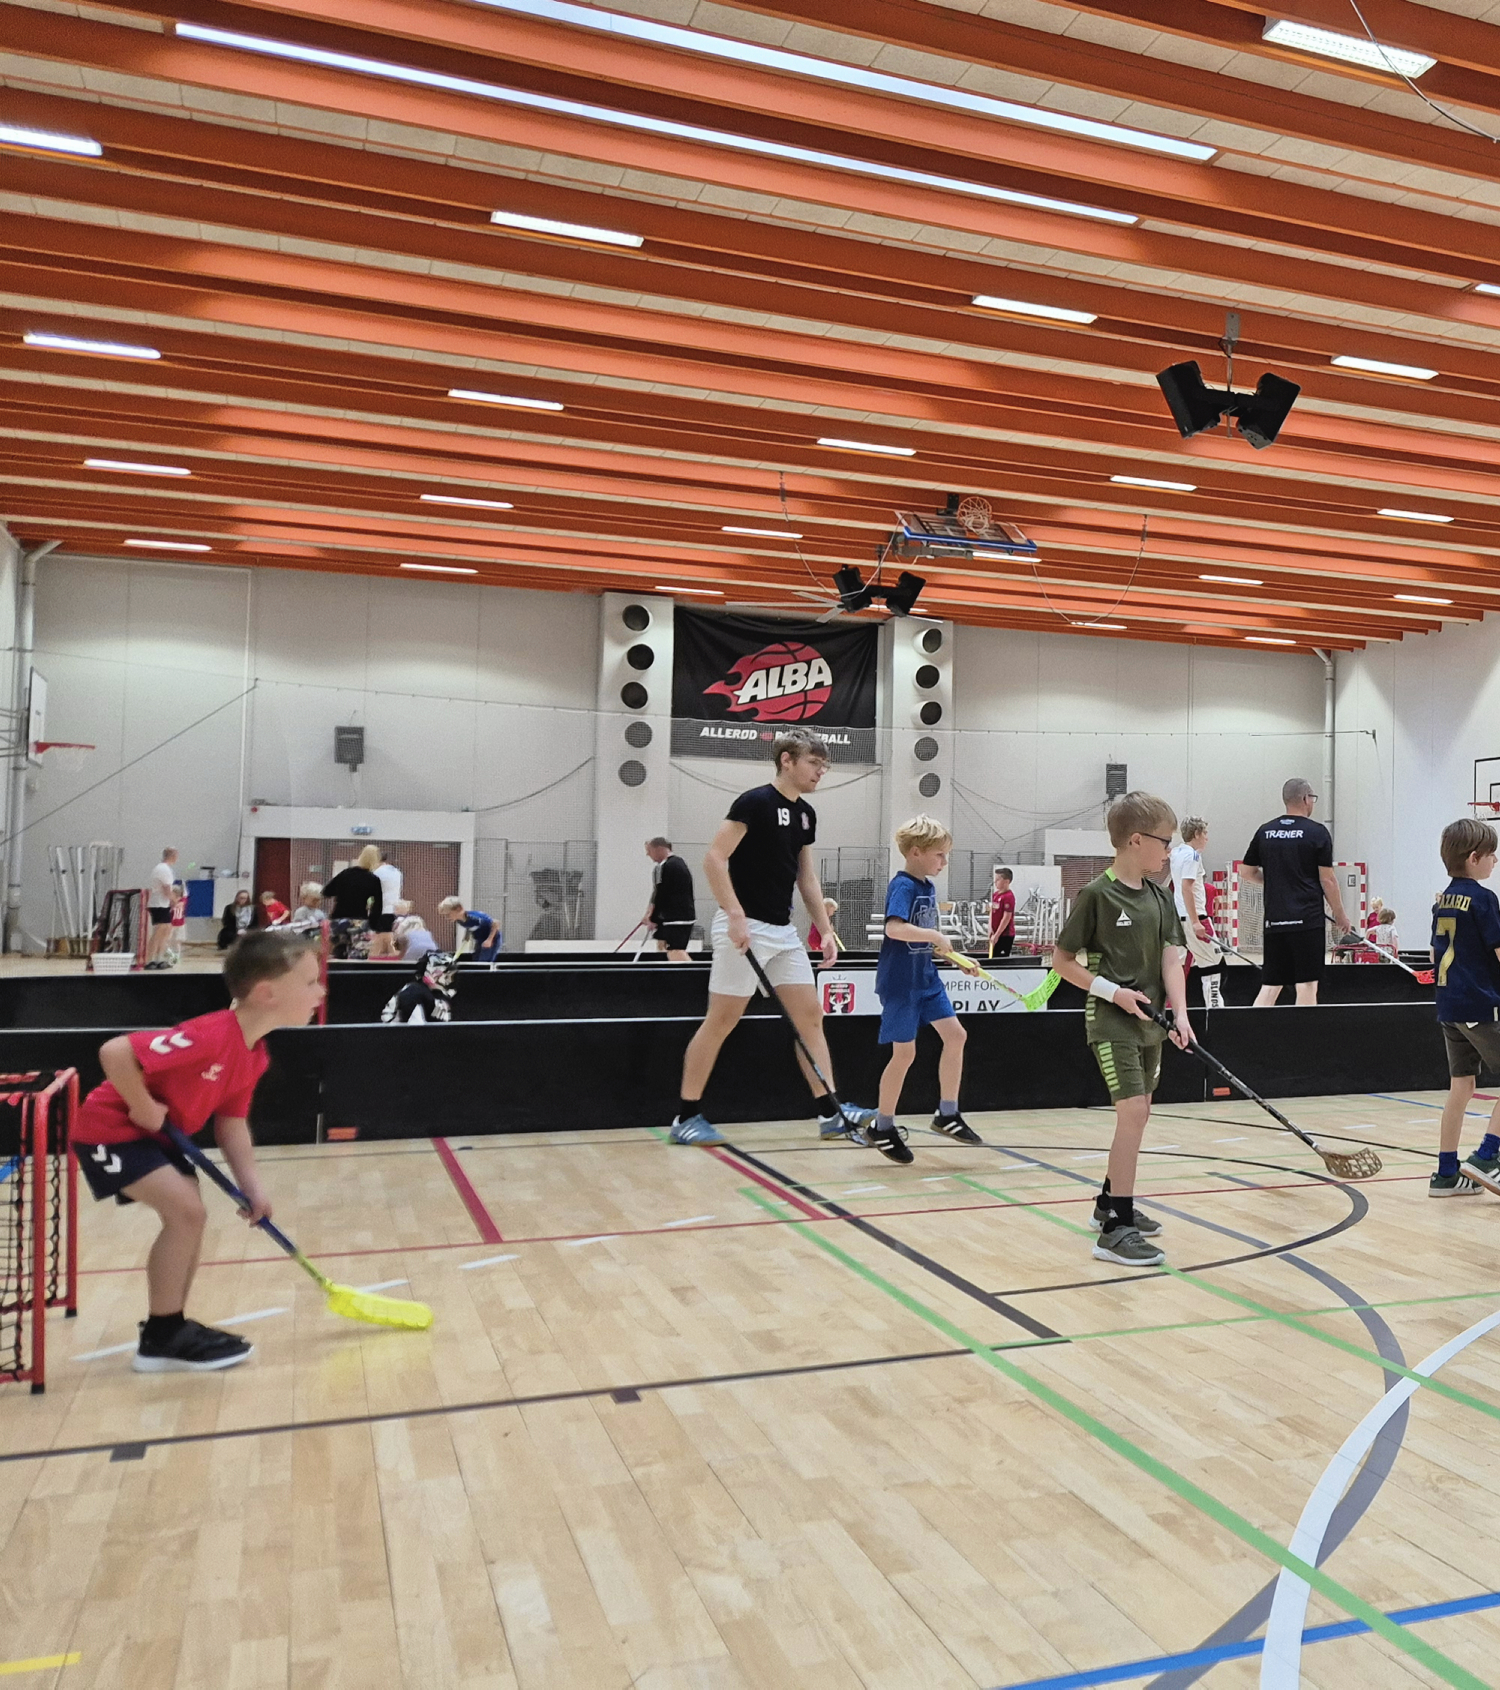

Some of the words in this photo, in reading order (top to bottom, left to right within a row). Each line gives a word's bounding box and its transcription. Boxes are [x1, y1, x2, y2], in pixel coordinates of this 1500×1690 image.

[732, 657, 833, 705] ALBA
[700, 726, 758, 740] ALLERØD
[777, 807, 790, 826] 19
[1264, 829, 1304, 839] TRÆNER
[1439, 894, 1472, 912] AZARD
[1436, 916, 1457, 987] 7
[944, 980, 971, 991] MPER
